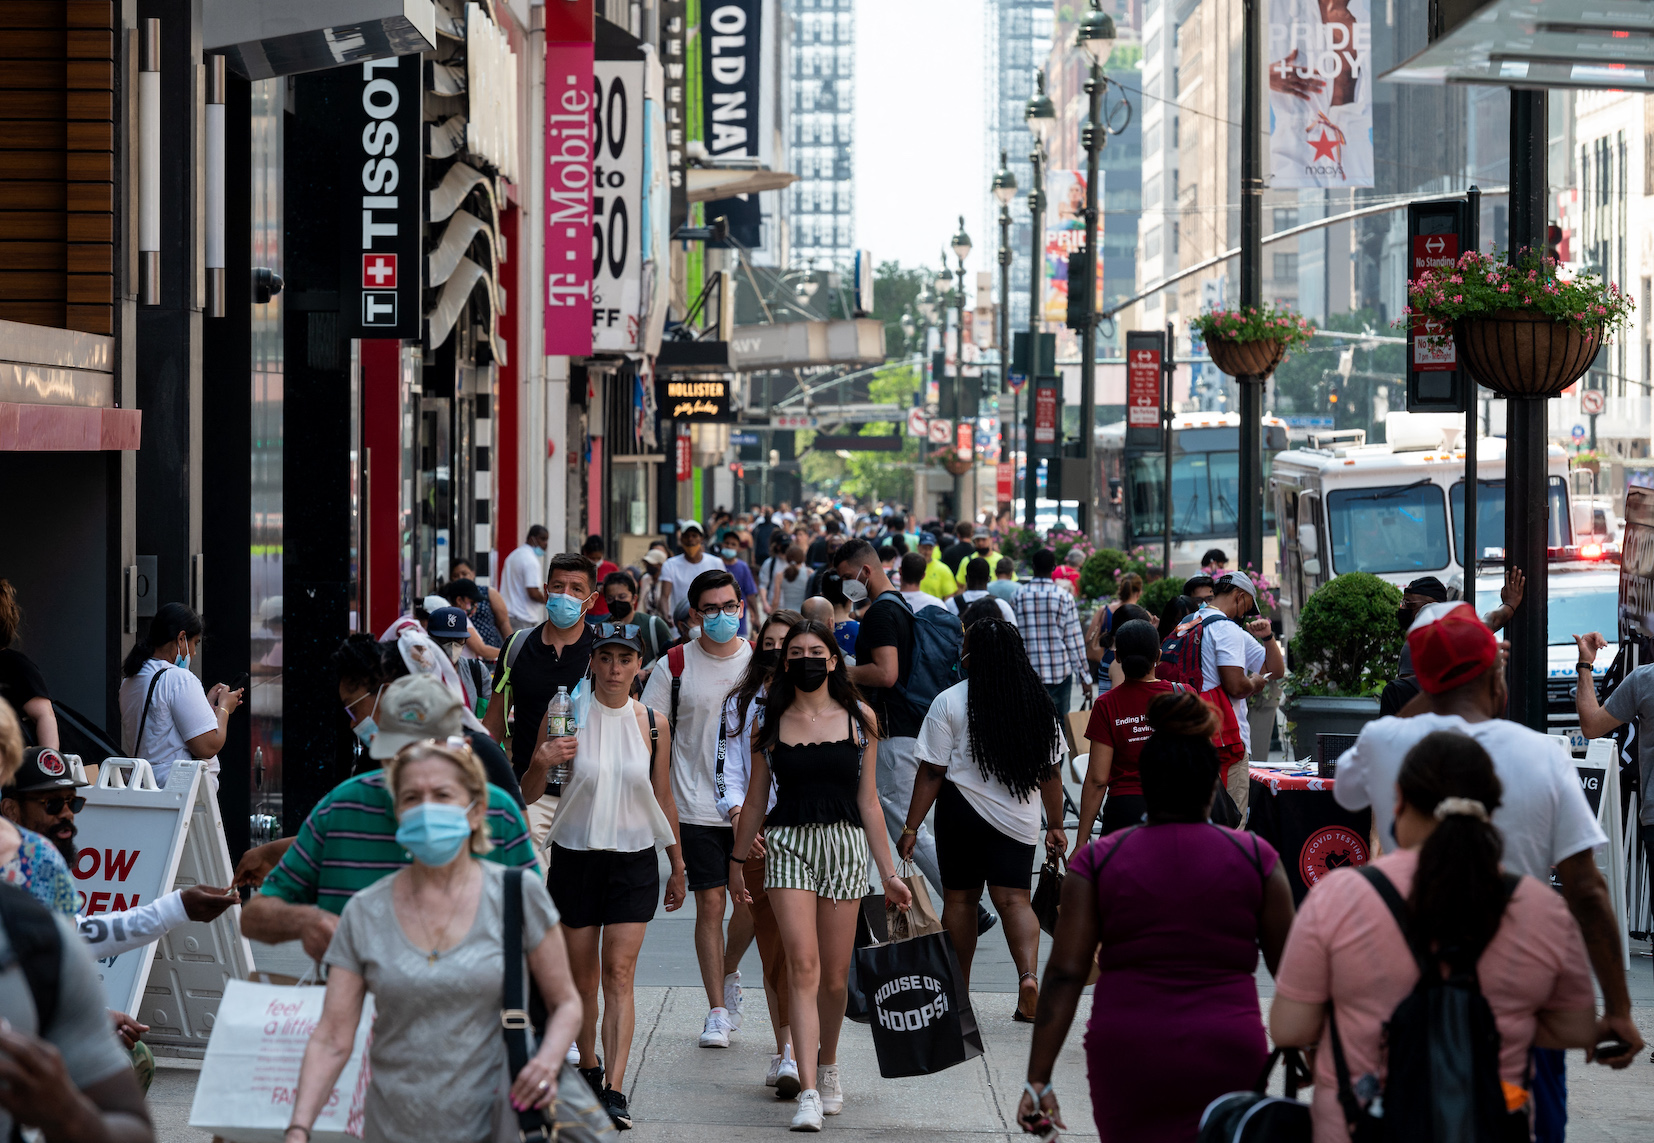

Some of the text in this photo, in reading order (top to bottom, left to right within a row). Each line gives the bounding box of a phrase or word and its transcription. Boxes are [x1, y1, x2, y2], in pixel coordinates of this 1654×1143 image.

[710, 5, 747, 85] OLD
[1269, 22, 1371, 51] PRIDE
[1274, 51, 1363, 80] +JOY
[666, 16, 684, 188] JEWELERS
[593, 165, 625, 188] to
[1416, 255, 1455, 269] No Standing
[593, 308, 620, 327] FF
[732, 337, 761, 352] AVY
[1418, 339, 1427, 349] No
[668, 383, 724, 397] HOLLISTER
[1621, 572, 1654, 619] TESTIN
[1115, 716, 1139, 726] Ending
[718, 739, 727, 760] GUESS
[1578, 777, 1598, 790] NG
[1309, 833, 1363, 861] COVID TESTING
[71, 847, 141, 882] OW
[1307, 865, 1320, 883] NEW
[77, 890, 141, 918] EN
[874, 975, 942, 1006] HOUSE OF
[265, 998, 304, 1017] feel
[263, 1021, 279, 1036] a
